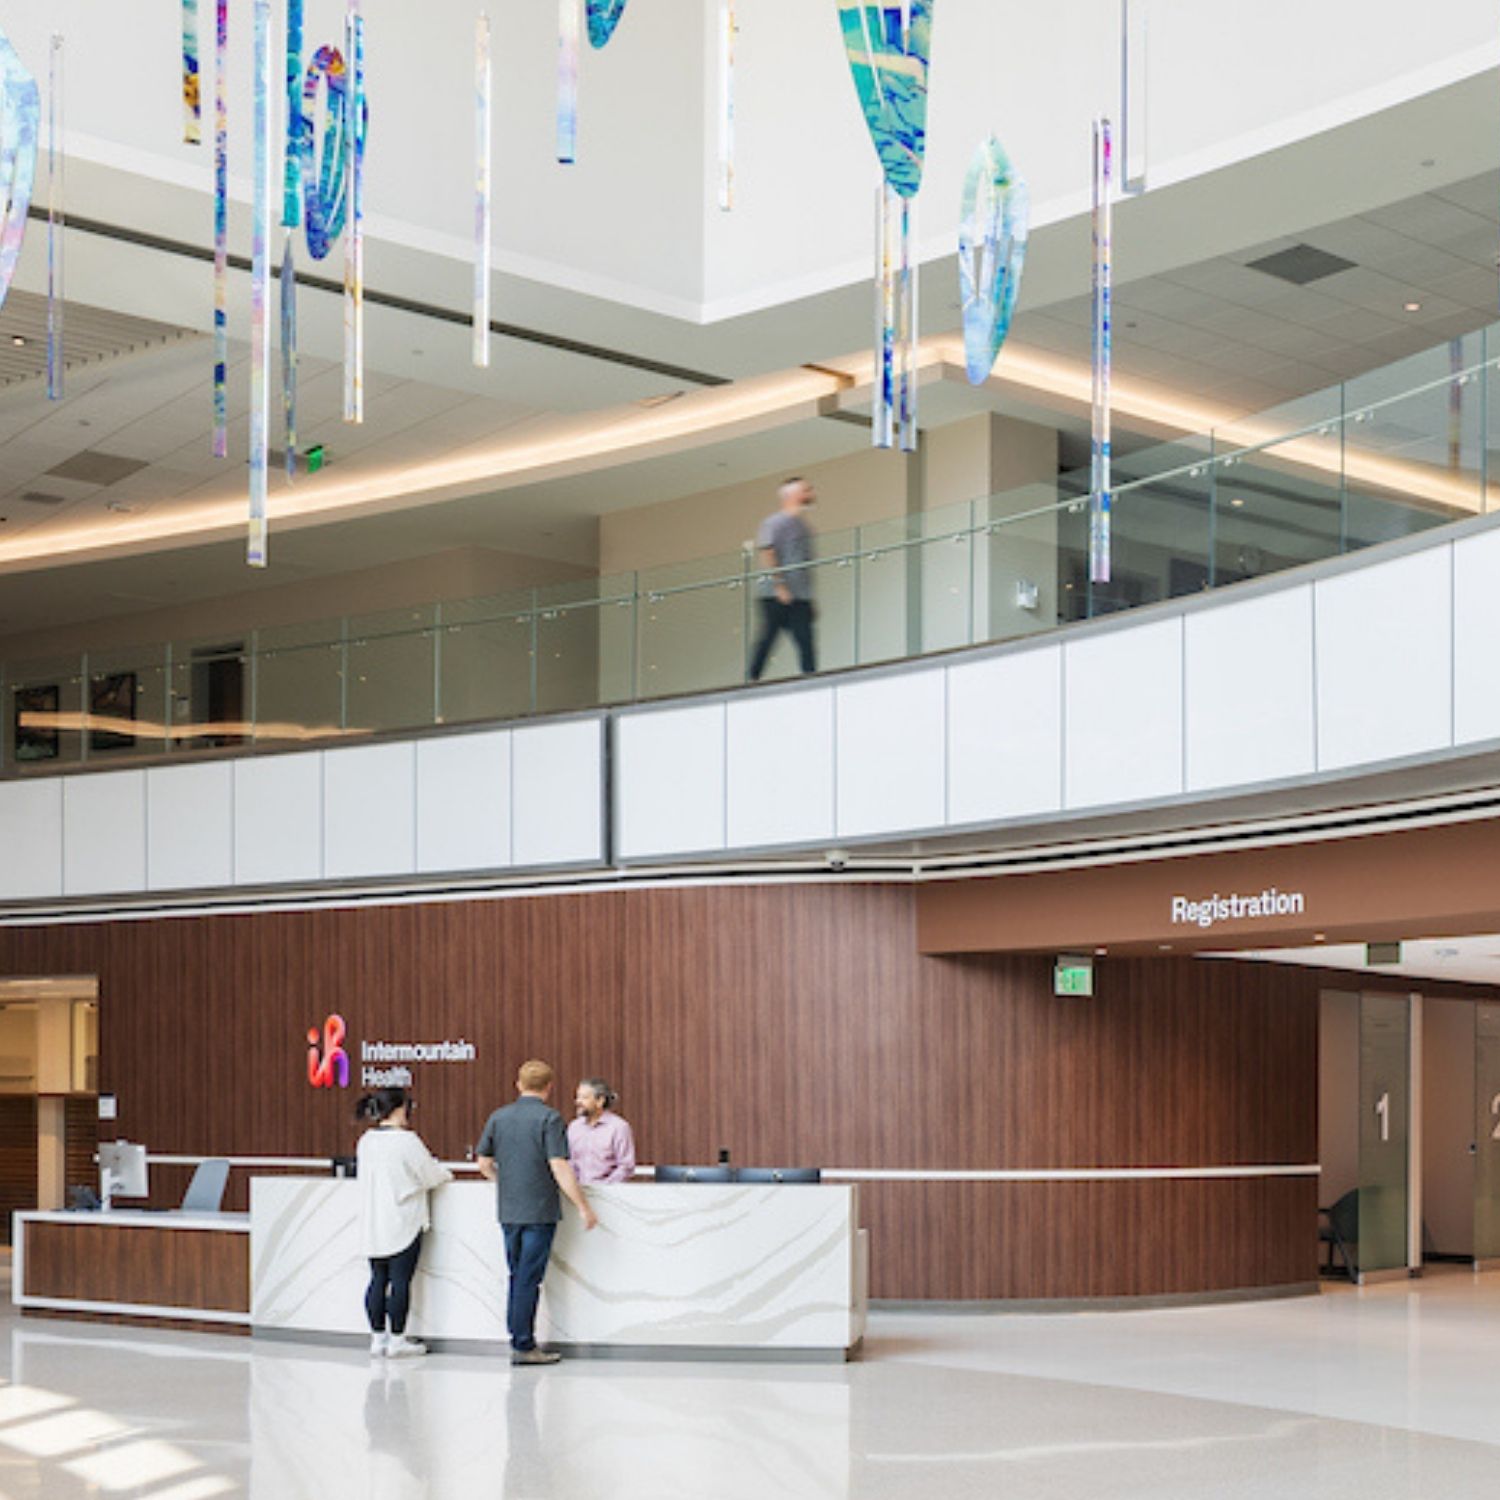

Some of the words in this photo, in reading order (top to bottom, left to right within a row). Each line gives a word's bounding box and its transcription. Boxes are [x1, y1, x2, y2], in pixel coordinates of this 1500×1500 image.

[1172, 888, 1304, 927] Registration
[361, 1038, 477, 1061] Intermountain
[361, 1066, 412, 1087] Health
[1375, 1092, 1389, 1141] 1
